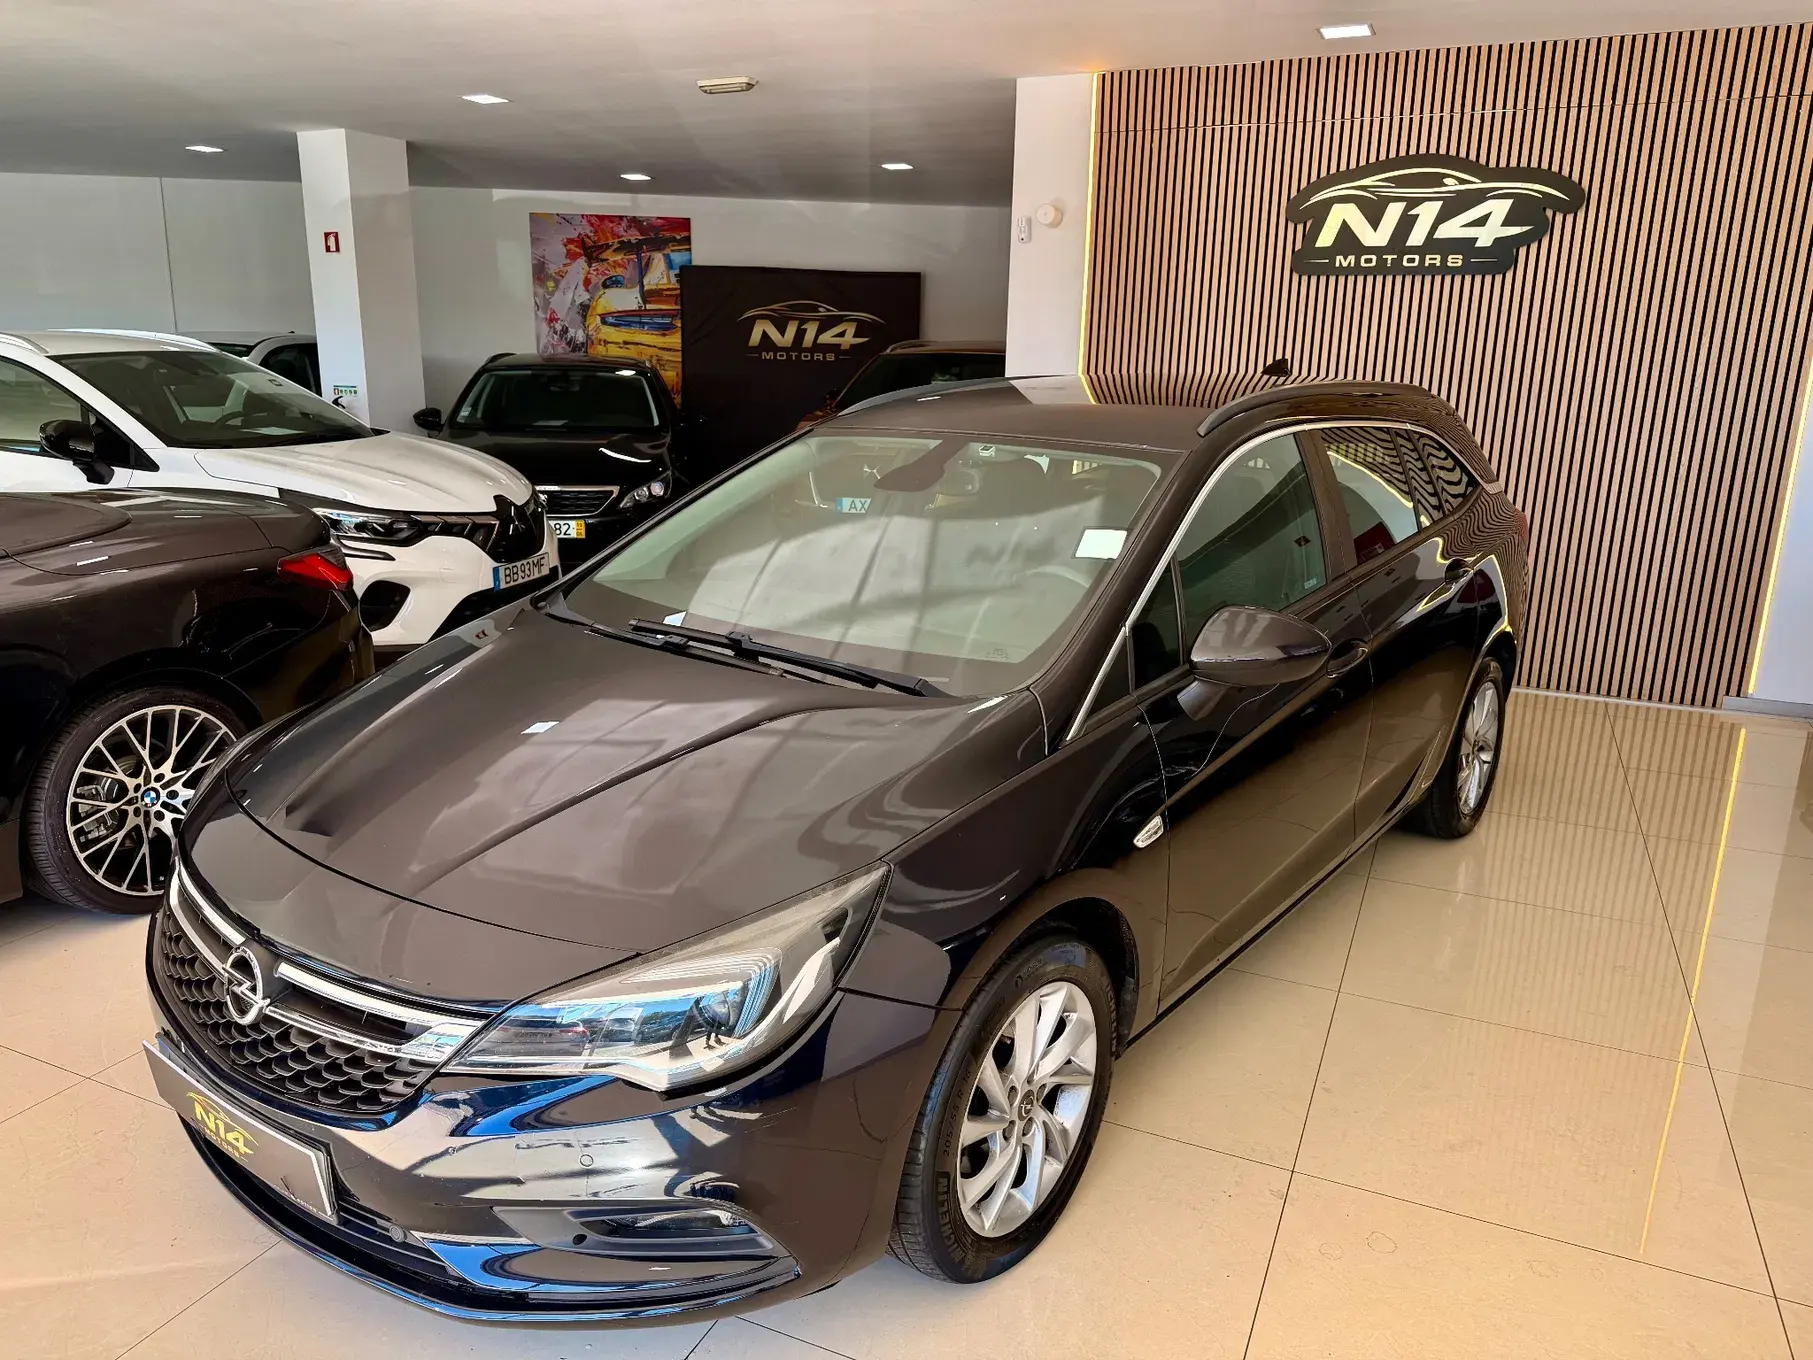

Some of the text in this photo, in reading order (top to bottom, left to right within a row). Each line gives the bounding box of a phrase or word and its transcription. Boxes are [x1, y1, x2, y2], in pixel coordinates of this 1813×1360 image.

[1314, 199, 1535, 248] N14
[1335, 254, 1464, 268] MOTORS
[748, 319, 871, 350] N14
[761, 351, 836, 361] MOTORS
[194, 1100, 254, 1155] N14
